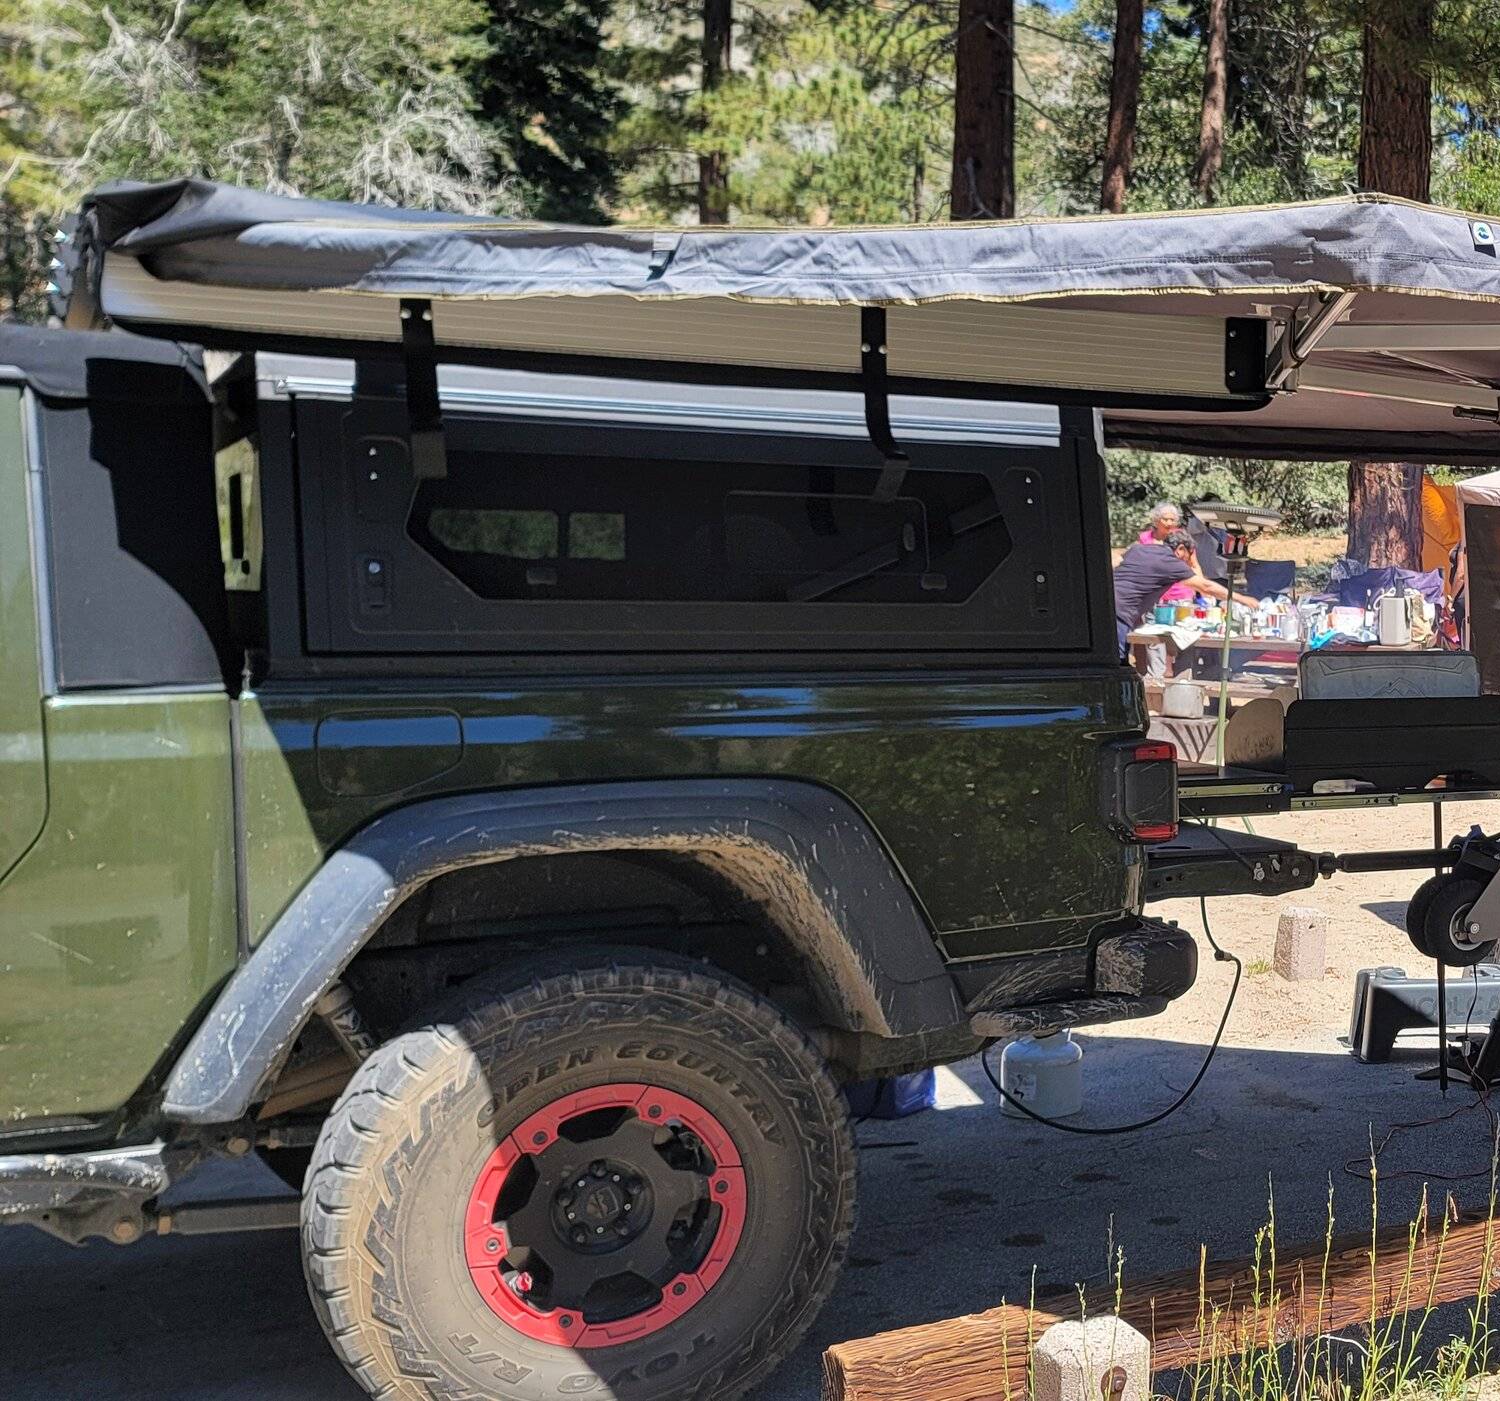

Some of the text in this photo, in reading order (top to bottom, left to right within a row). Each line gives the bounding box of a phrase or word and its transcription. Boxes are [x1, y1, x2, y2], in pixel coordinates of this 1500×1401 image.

[477, 1040, 785, 1146] OPEN COUNTRY
[446, 1332, 533, 1385] R/T
[556, 1331, 717, 1394] TOYO
